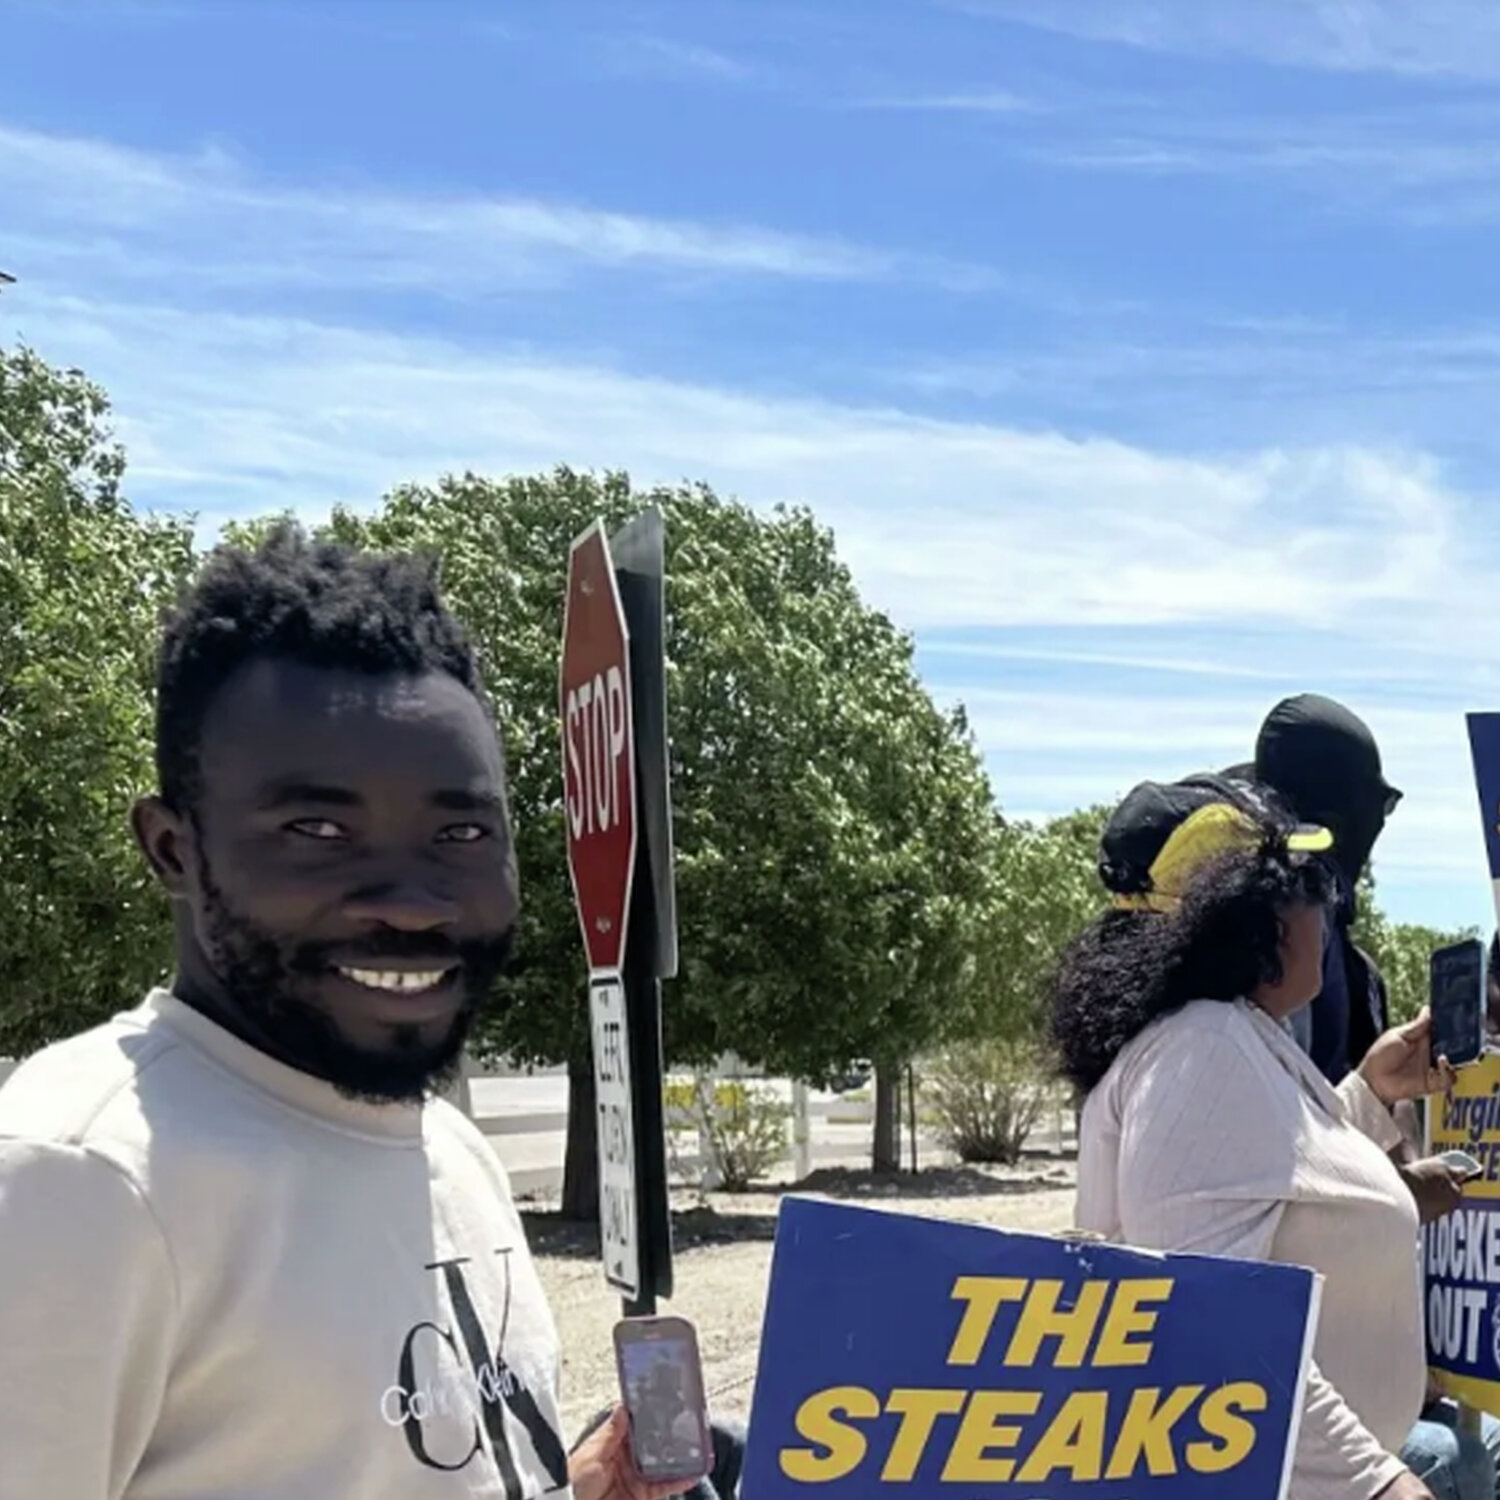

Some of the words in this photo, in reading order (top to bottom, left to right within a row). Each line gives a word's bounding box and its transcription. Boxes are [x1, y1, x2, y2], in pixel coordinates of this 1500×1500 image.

[567, 665, 626, 841] STOP
[946, 1275, 1175, 1368] THE
[1428, 1283, 1488, 1364] OUT
[779, 1380, 1268, 1484] STEAKS
